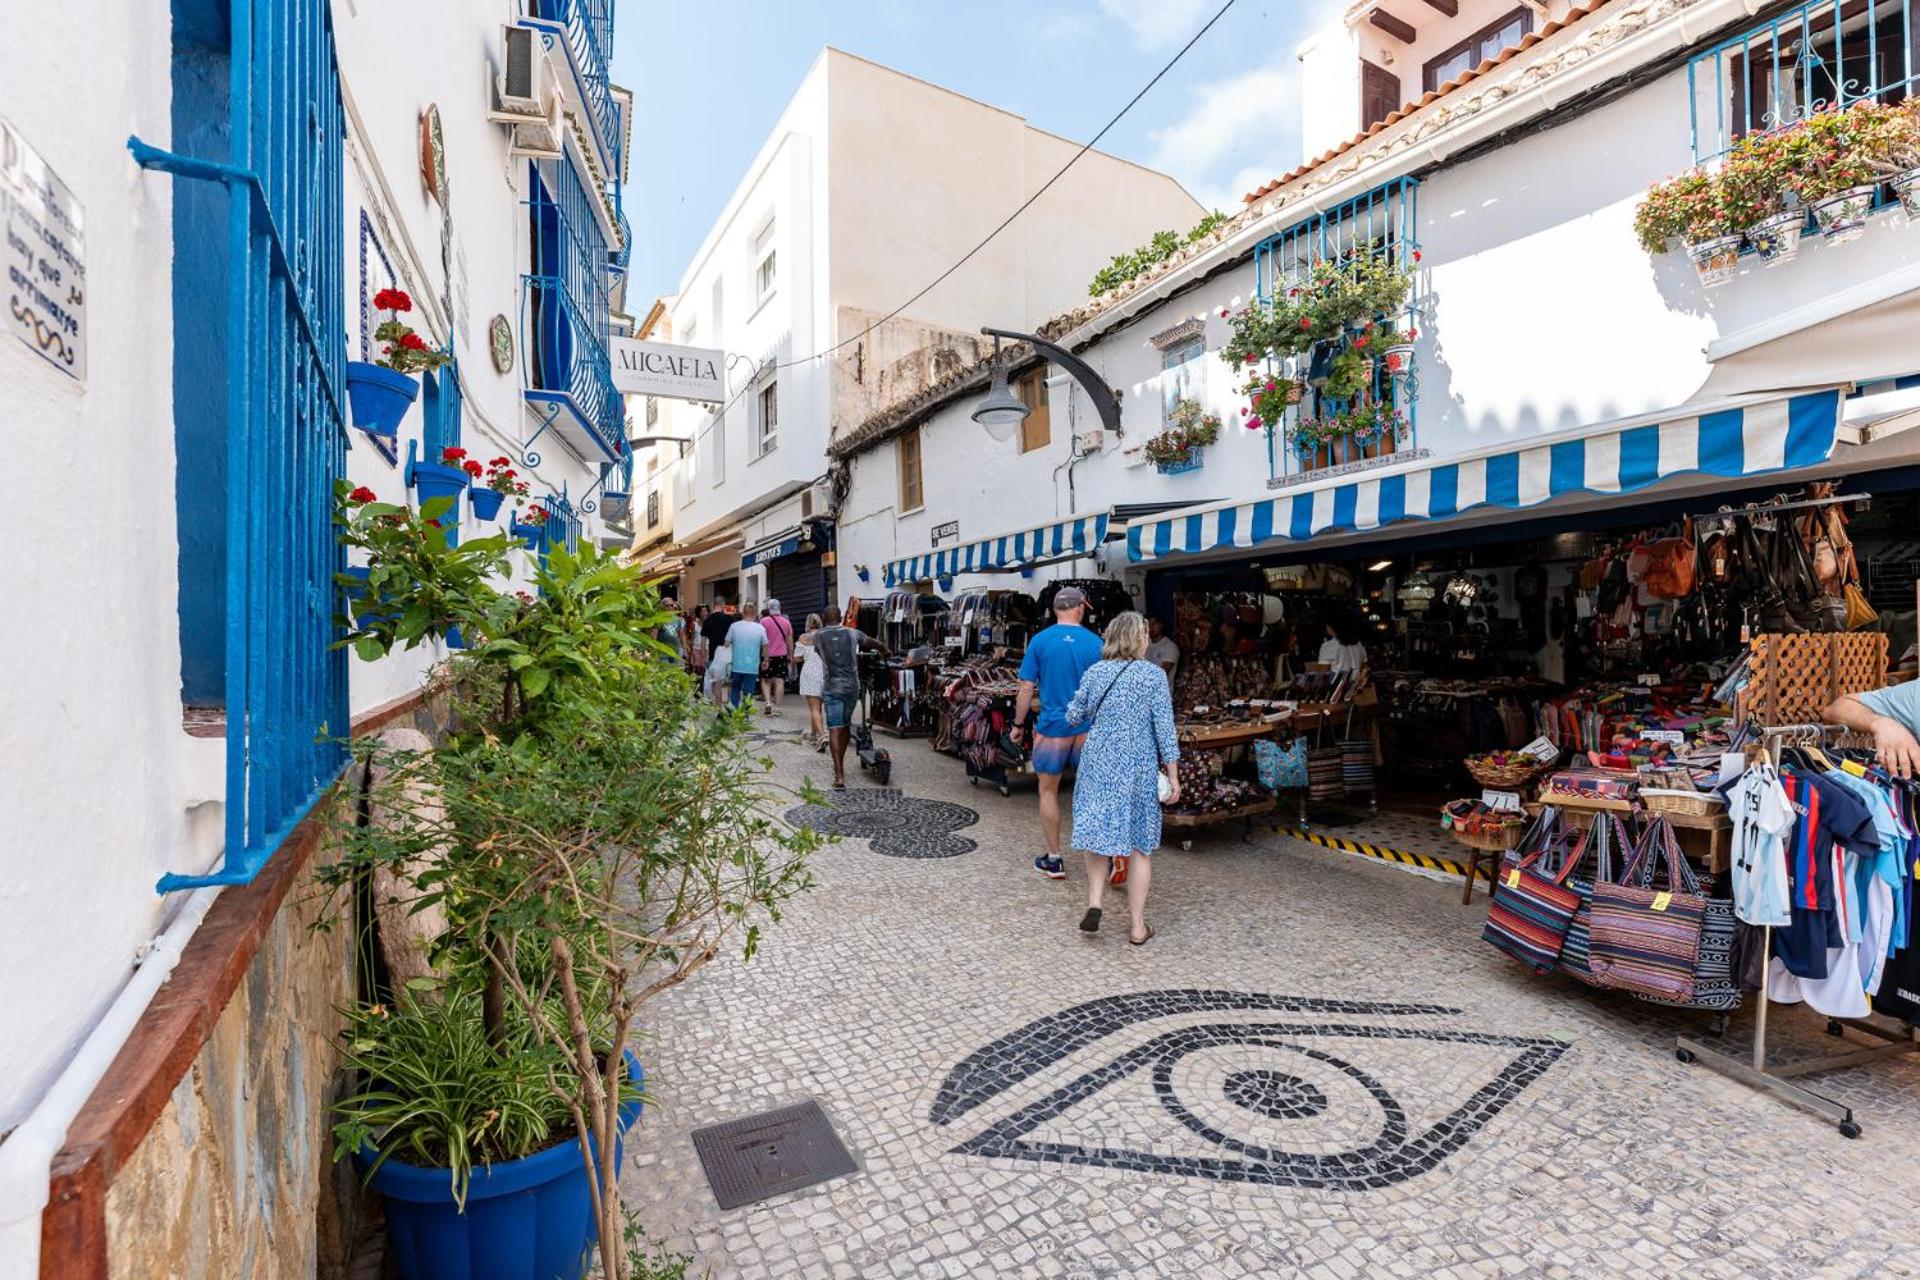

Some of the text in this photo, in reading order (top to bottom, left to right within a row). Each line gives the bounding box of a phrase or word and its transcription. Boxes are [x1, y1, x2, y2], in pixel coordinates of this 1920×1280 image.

[7, 219, 61, 288] hay que
[618, 348, 719, 381] MICAELA
